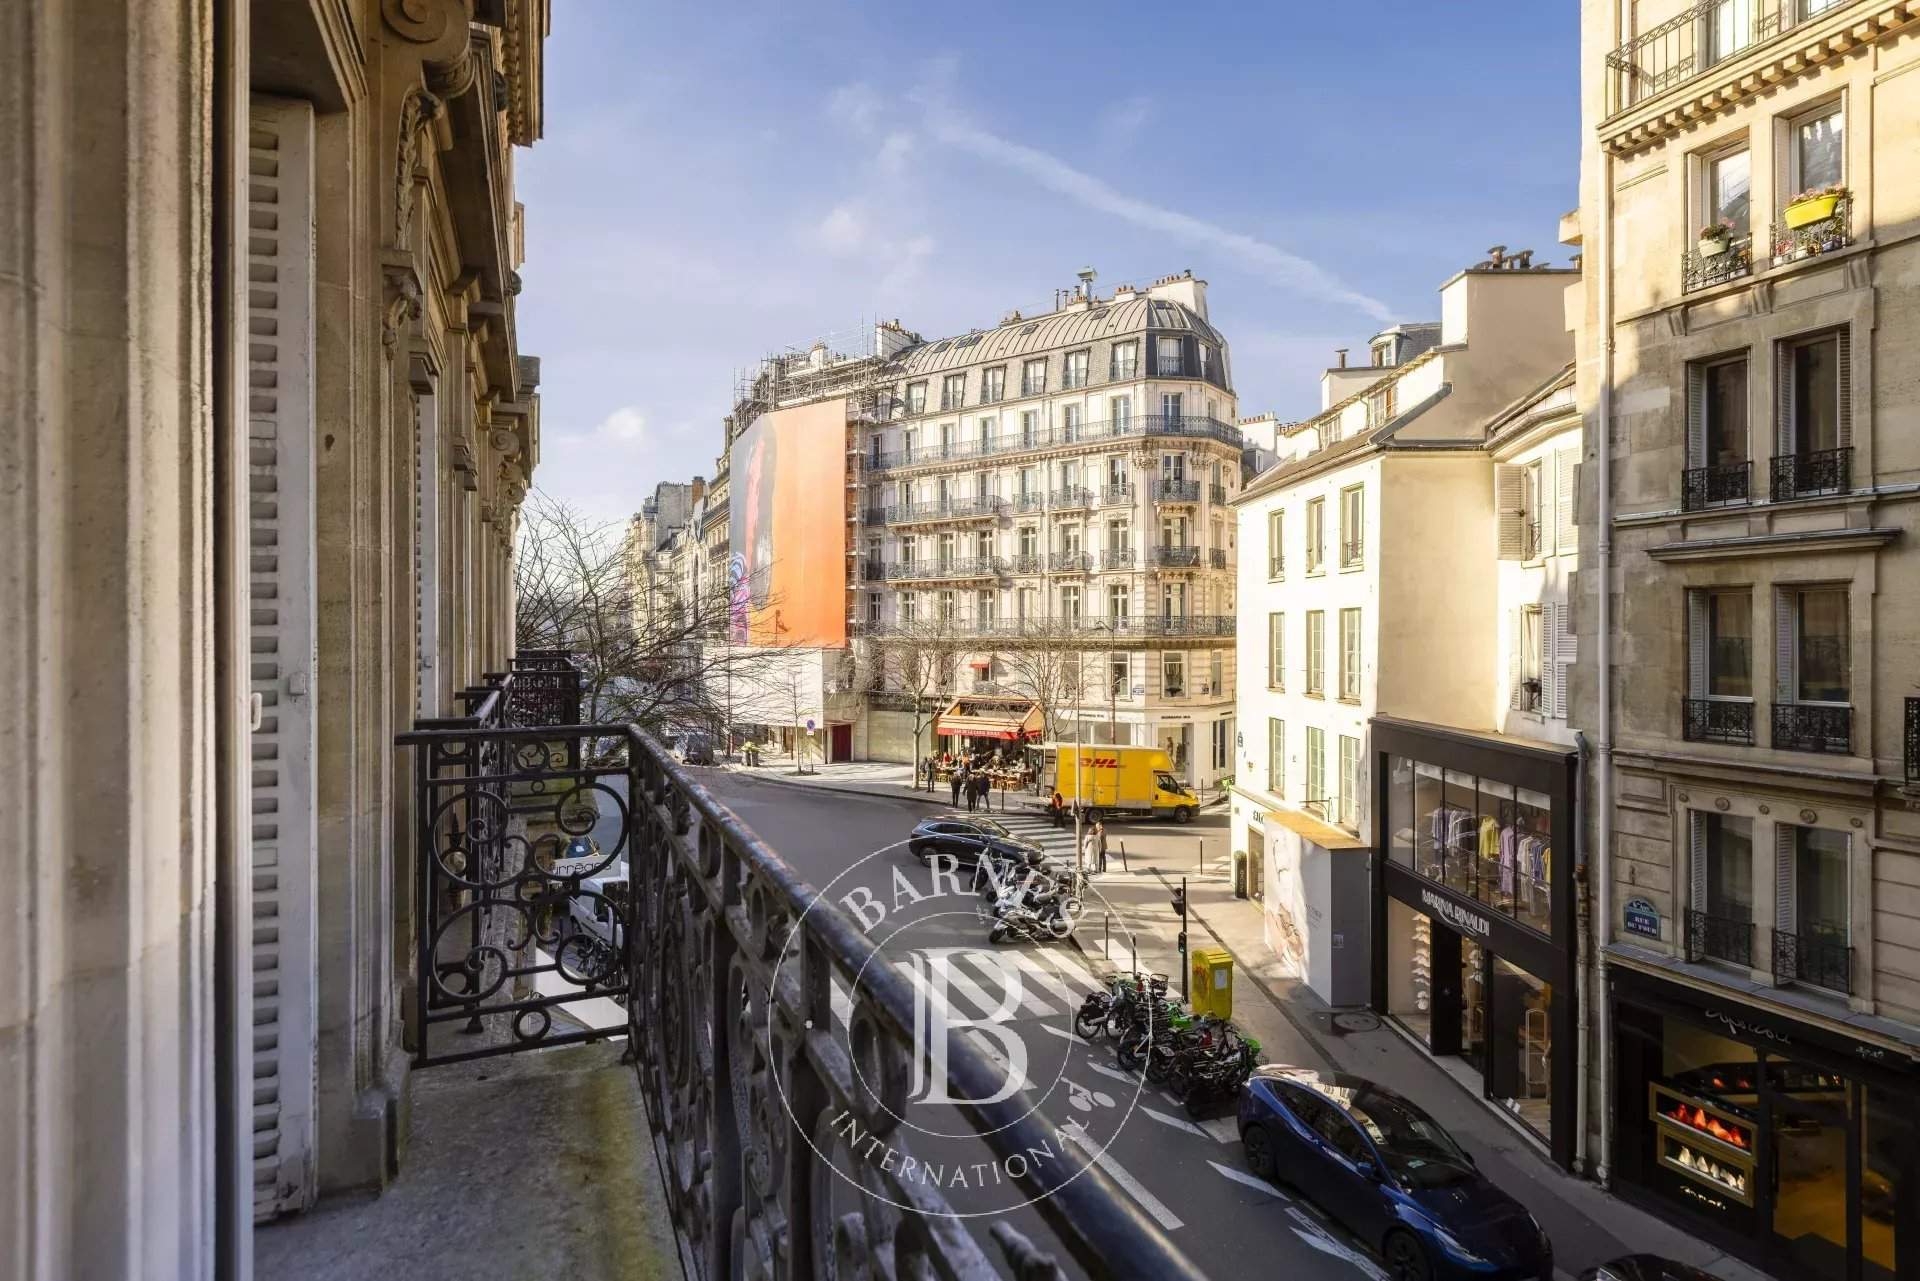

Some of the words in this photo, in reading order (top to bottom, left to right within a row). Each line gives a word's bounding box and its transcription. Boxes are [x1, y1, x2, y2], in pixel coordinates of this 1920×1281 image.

[1078, 757, 1118, 768] DHL
[1422, 889, 1455, 918] MARINA
[1454, 905, 1490, 937] RINALDI
